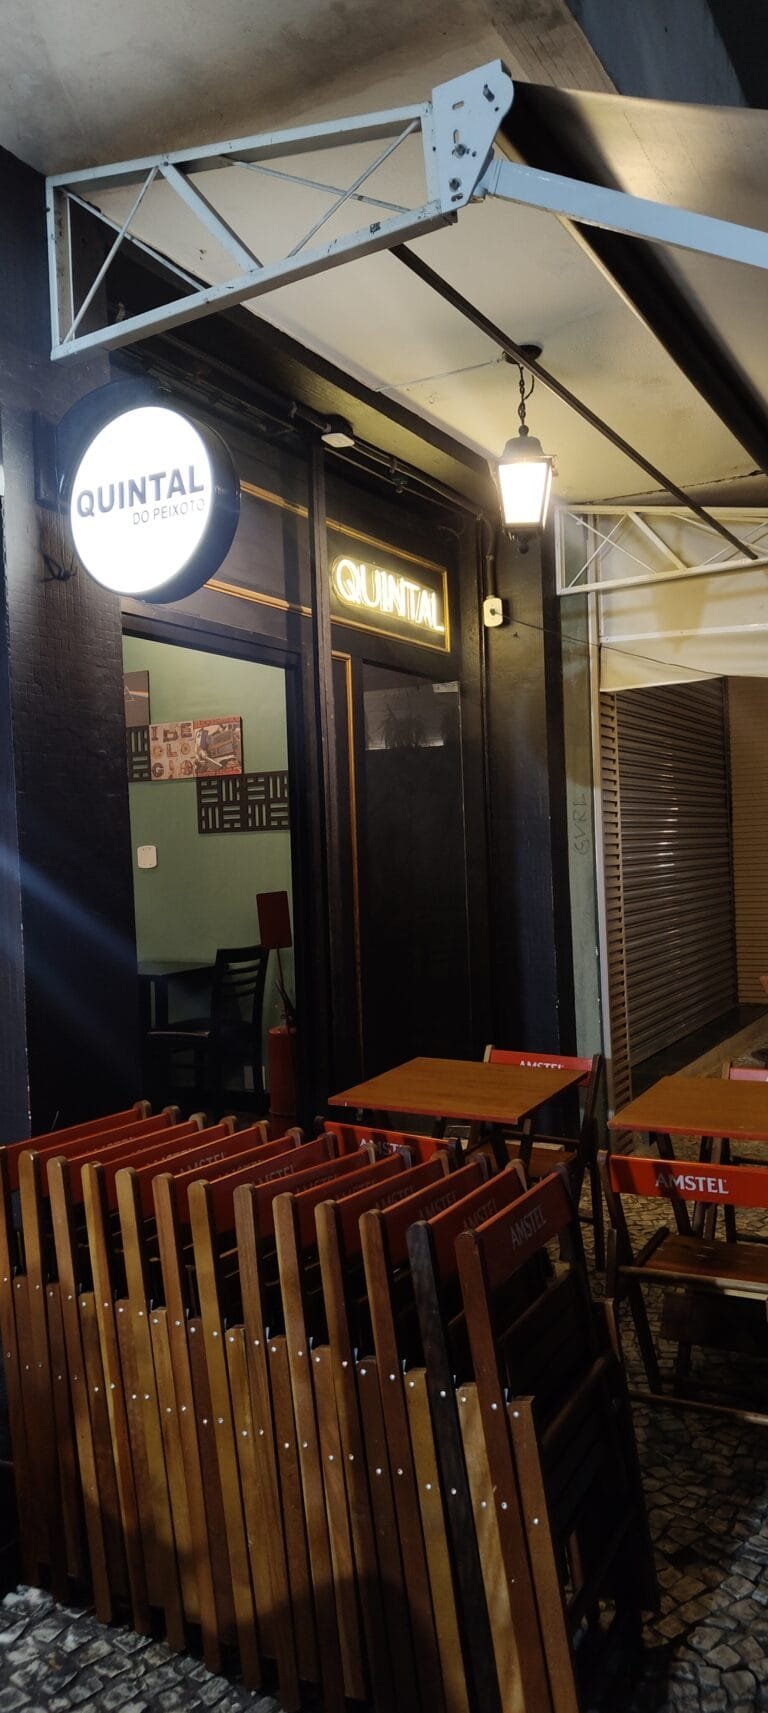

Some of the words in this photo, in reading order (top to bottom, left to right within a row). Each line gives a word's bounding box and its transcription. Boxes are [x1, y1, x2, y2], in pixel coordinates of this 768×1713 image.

[76, 464, 205, 518] QUINTAL
[132, 510, 150, 525] DO
[153, 498, 205, 521] PEIXOTO
[333, 556, 446, 632] QUINTAL
[655, 1173, 729, 1194] AMSTEL
[509, 1202, 548, 1250] AMSTEL
